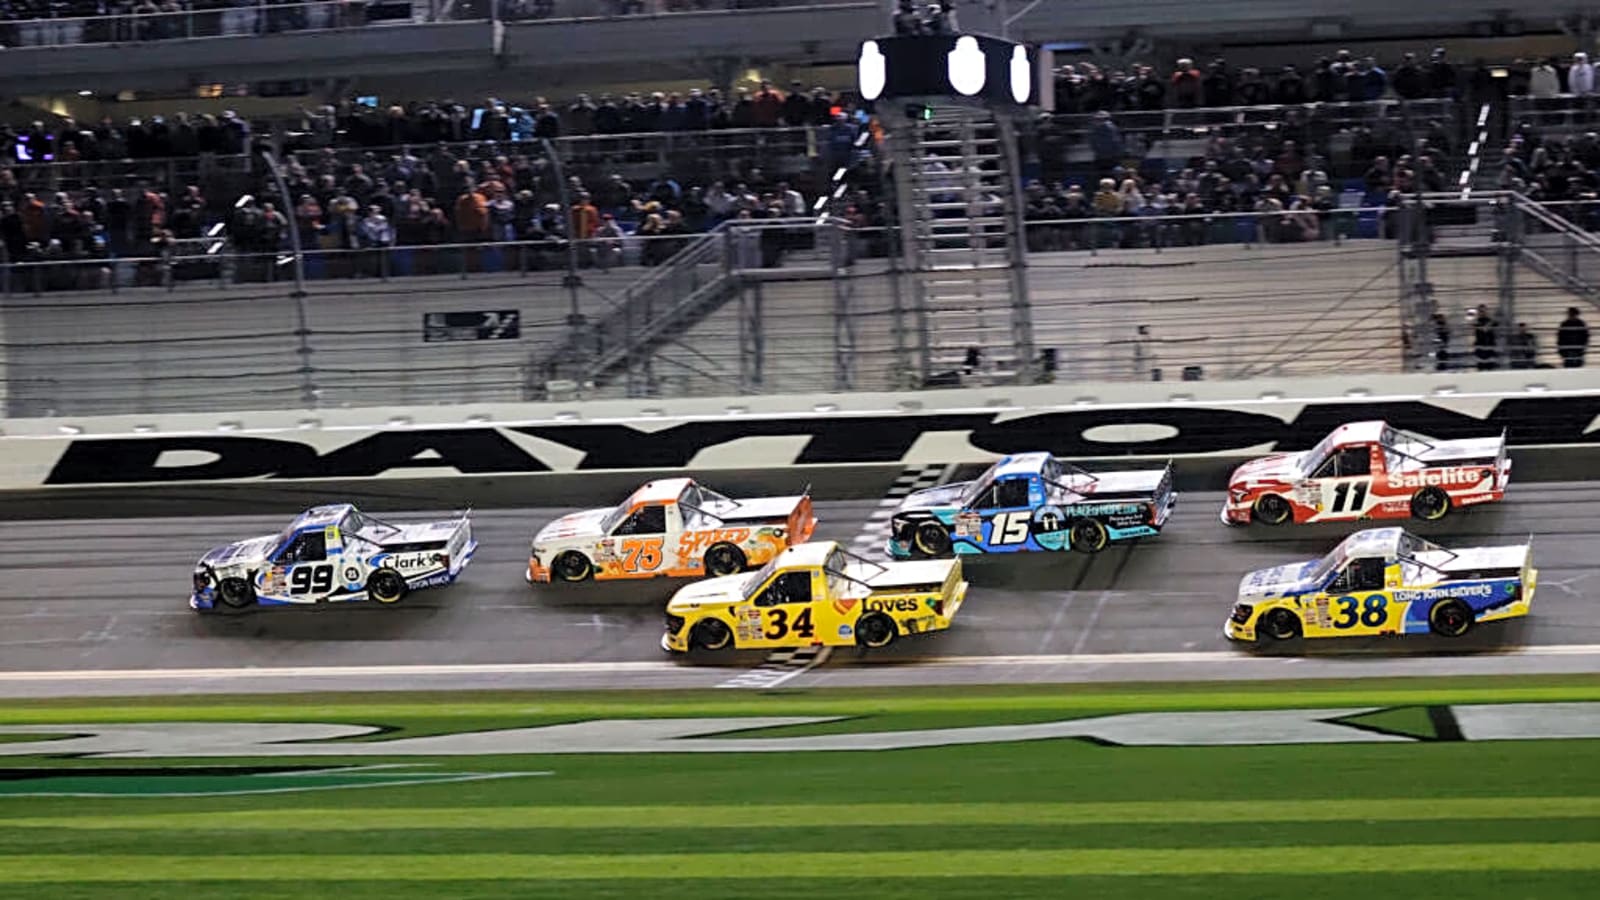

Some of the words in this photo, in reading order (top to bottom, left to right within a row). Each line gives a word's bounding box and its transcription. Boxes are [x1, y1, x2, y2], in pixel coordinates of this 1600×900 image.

[1387, 469, 1479, 488] Safelite
[1332, 481, 1369, 512] 11
[989, 511, 1032, 544] 15
[621, 536, 664, 572] 75
[290, 564, 334, 595] 99
[764, 607, 815, 640] 34
[1333, 594, 1388, 629] 38
